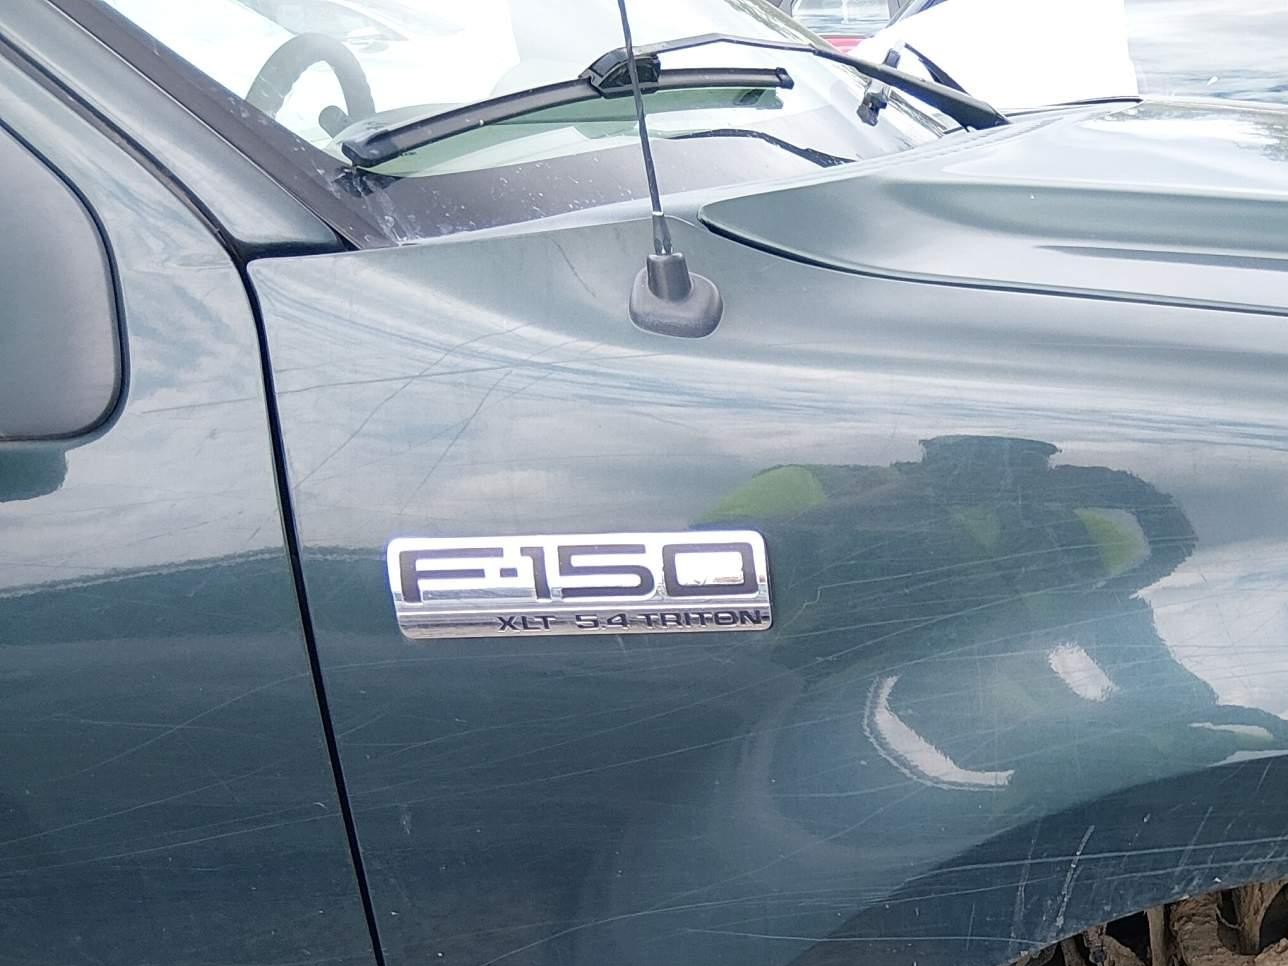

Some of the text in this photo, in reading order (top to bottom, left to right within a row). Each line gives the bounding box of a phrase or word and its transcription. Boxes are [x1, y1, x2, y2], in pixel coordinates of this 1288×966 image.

[399, 542, 759, 603] F-150
[497, 609, 764, 632] XLT 5.4 TRITON
